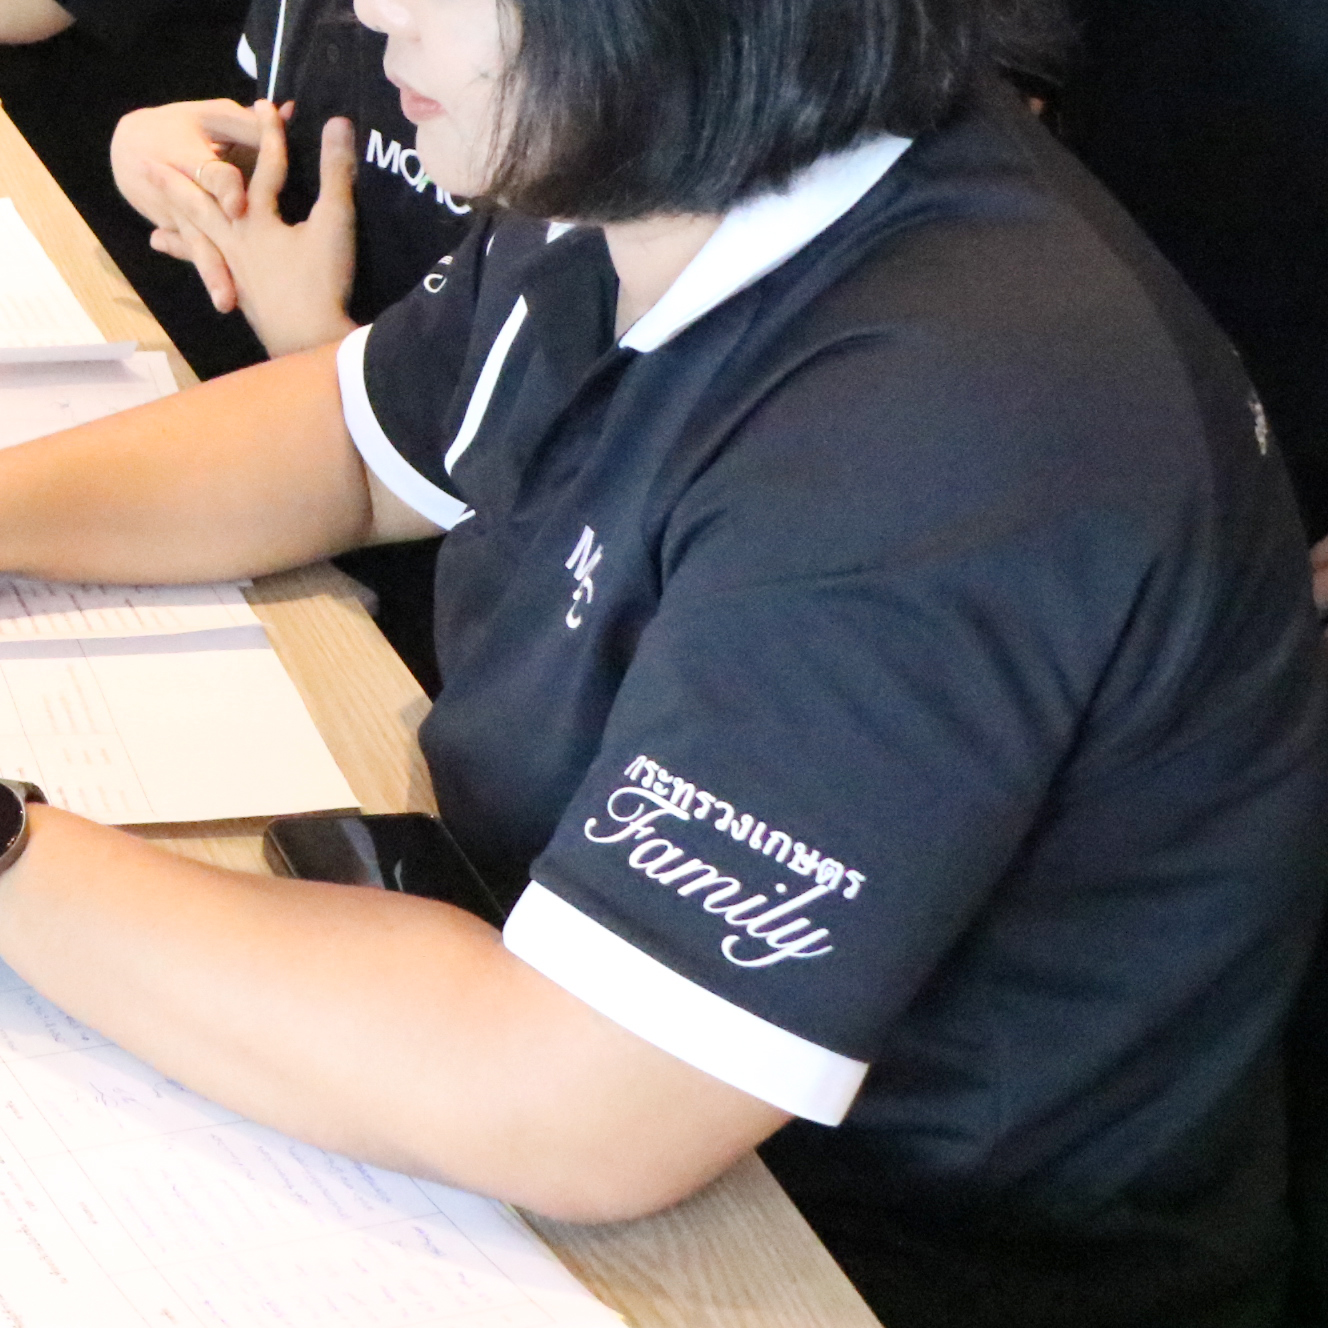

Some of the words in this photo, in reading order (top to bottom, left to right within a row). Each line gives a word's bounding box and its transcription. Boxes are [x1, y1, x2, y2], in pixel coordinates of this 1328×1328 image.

[584, 786, 833, 967] Family
[624, 755, 866, 899] กระทรวงเกษตร
